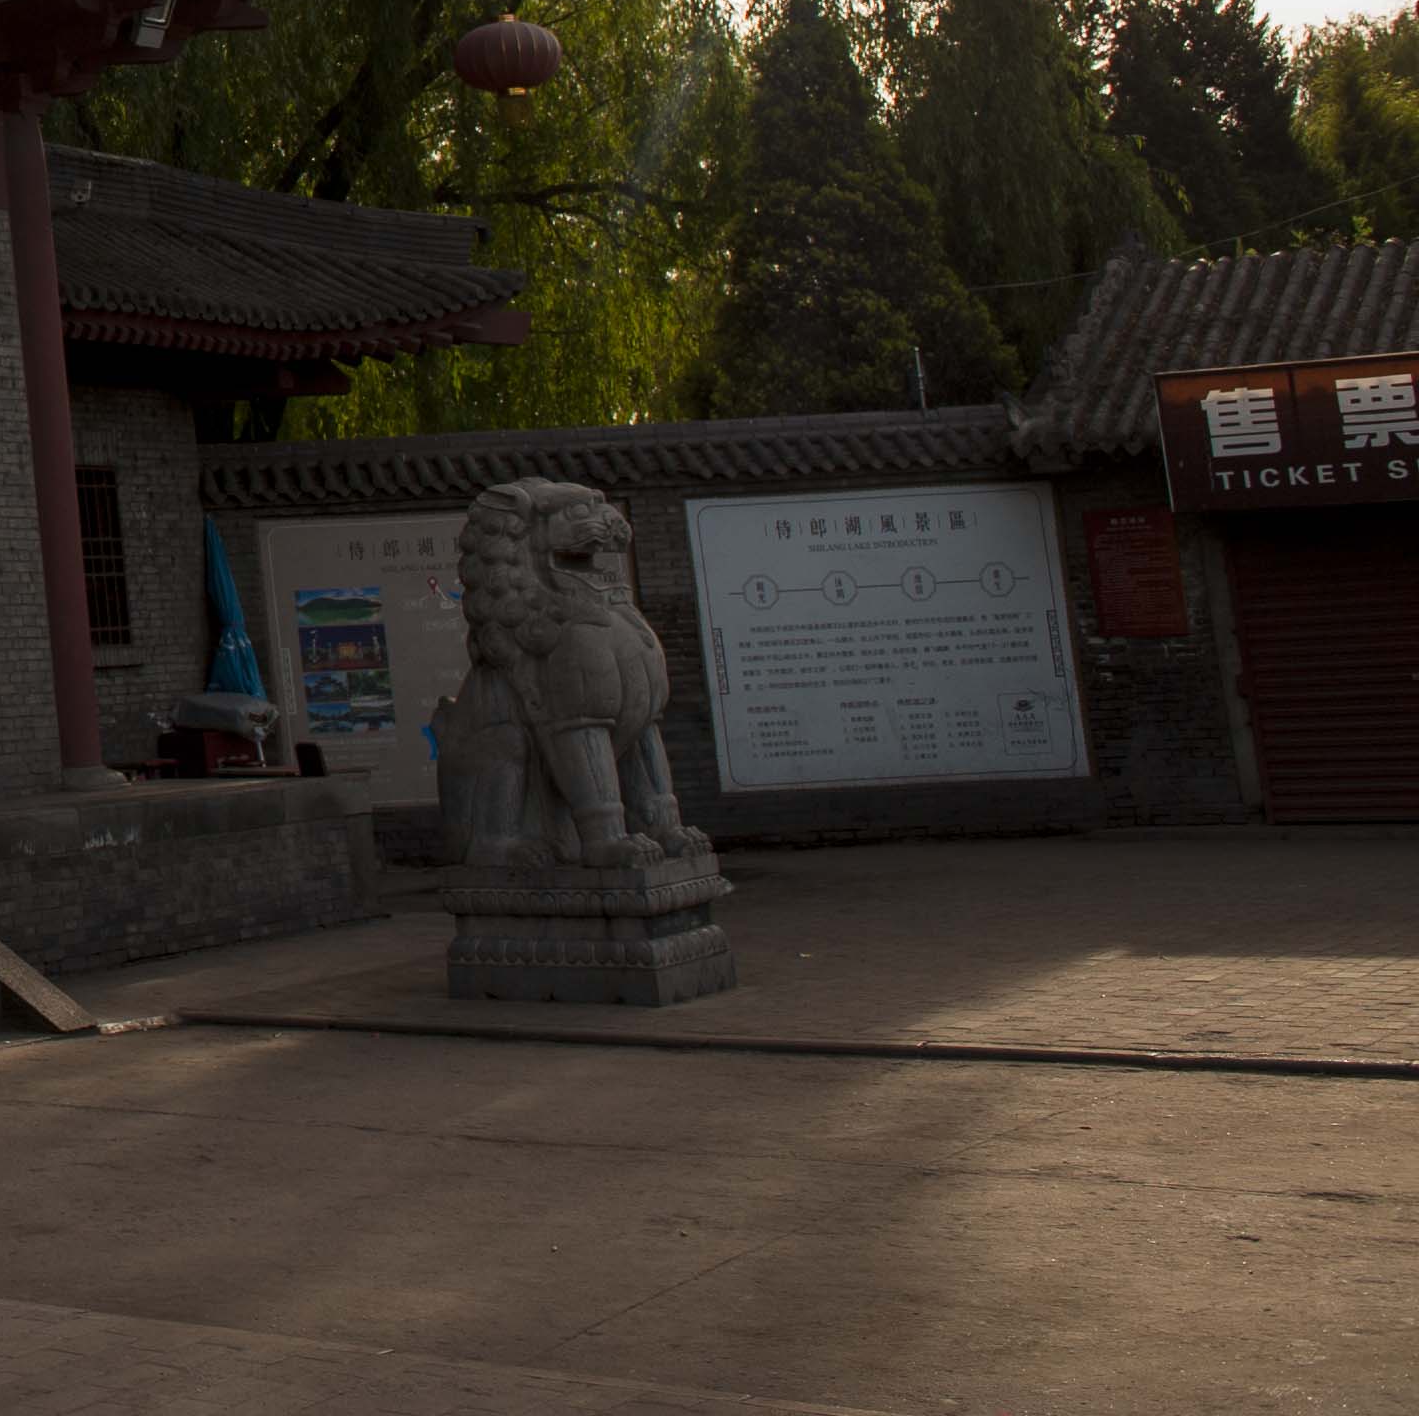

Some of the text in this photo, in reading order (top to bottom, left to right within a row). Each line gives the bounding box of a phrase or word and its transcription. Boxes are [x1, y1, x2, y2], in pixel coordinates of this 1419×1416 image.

[1199, 373, 1419, 458] 售票
[1215, 457, 1419, 491] TICKET S
